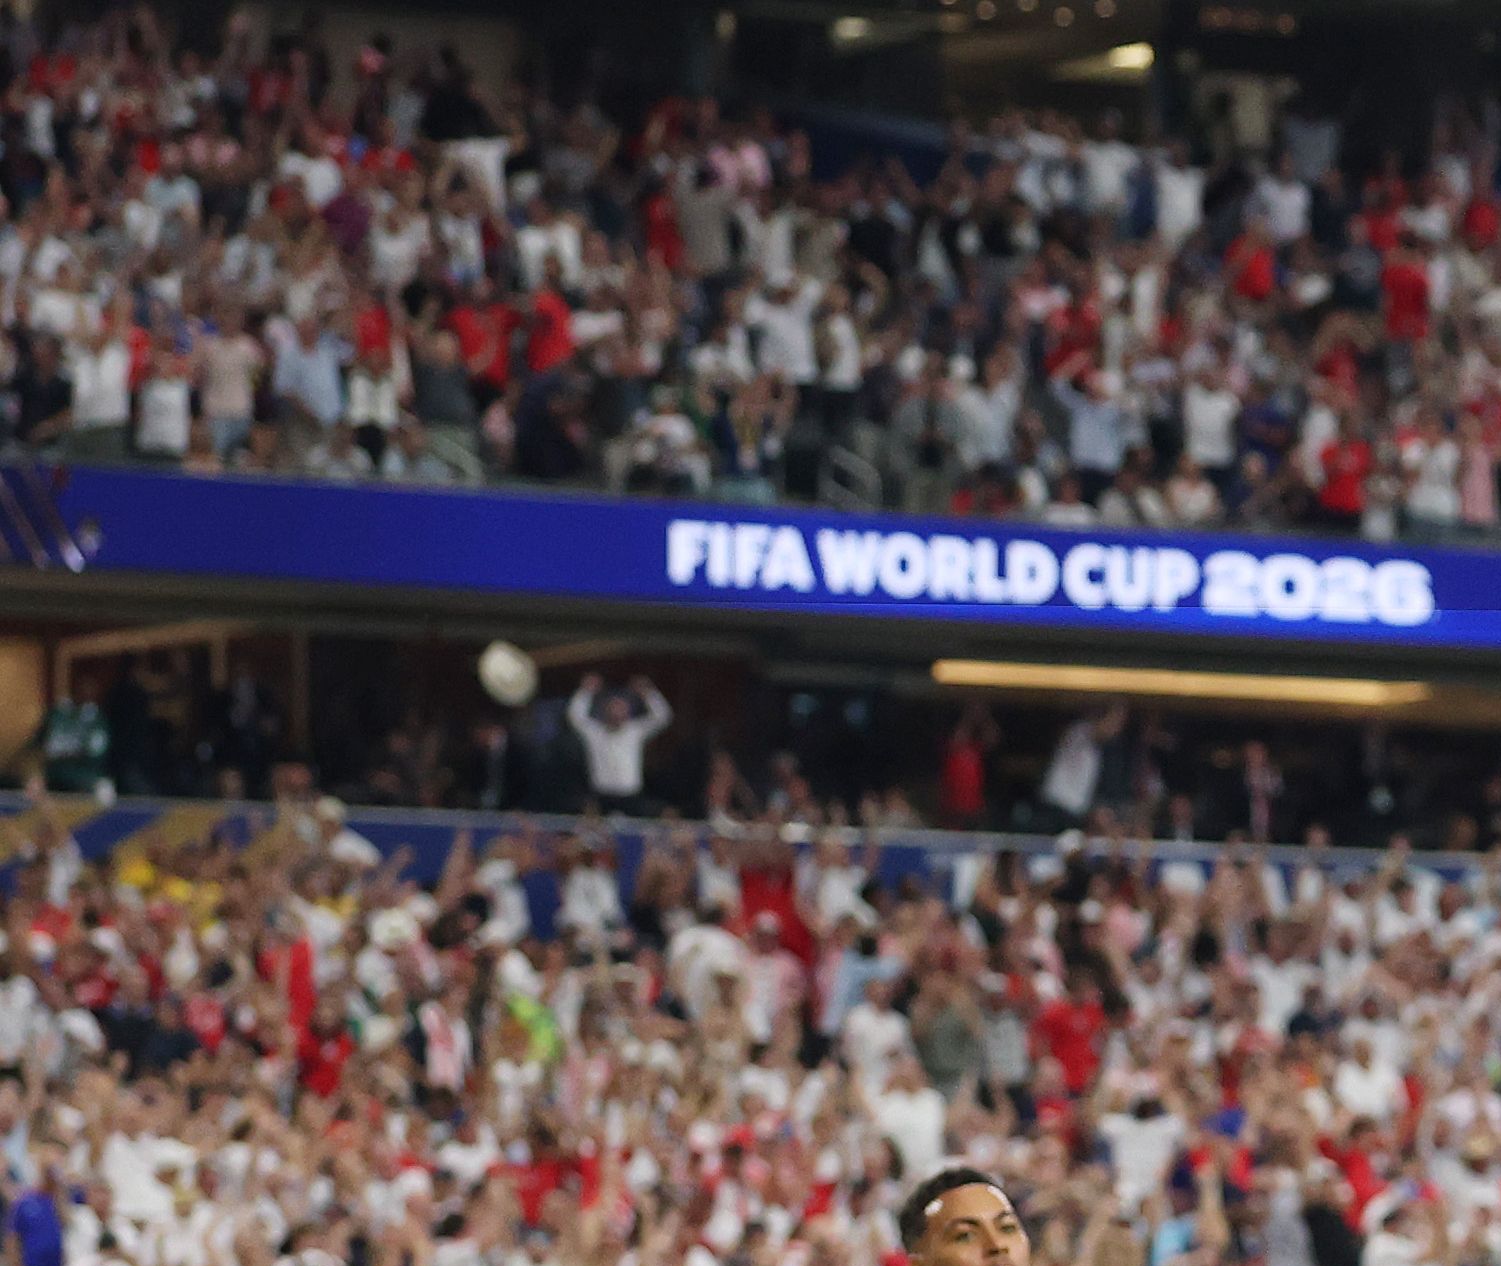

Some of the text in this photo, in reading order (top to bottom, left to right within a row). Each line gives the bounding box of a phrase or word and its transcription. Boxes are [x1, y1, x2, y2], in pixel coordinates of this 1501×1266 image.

[666, 518, 1435, 626] FIFA WORLD CUP 2026
